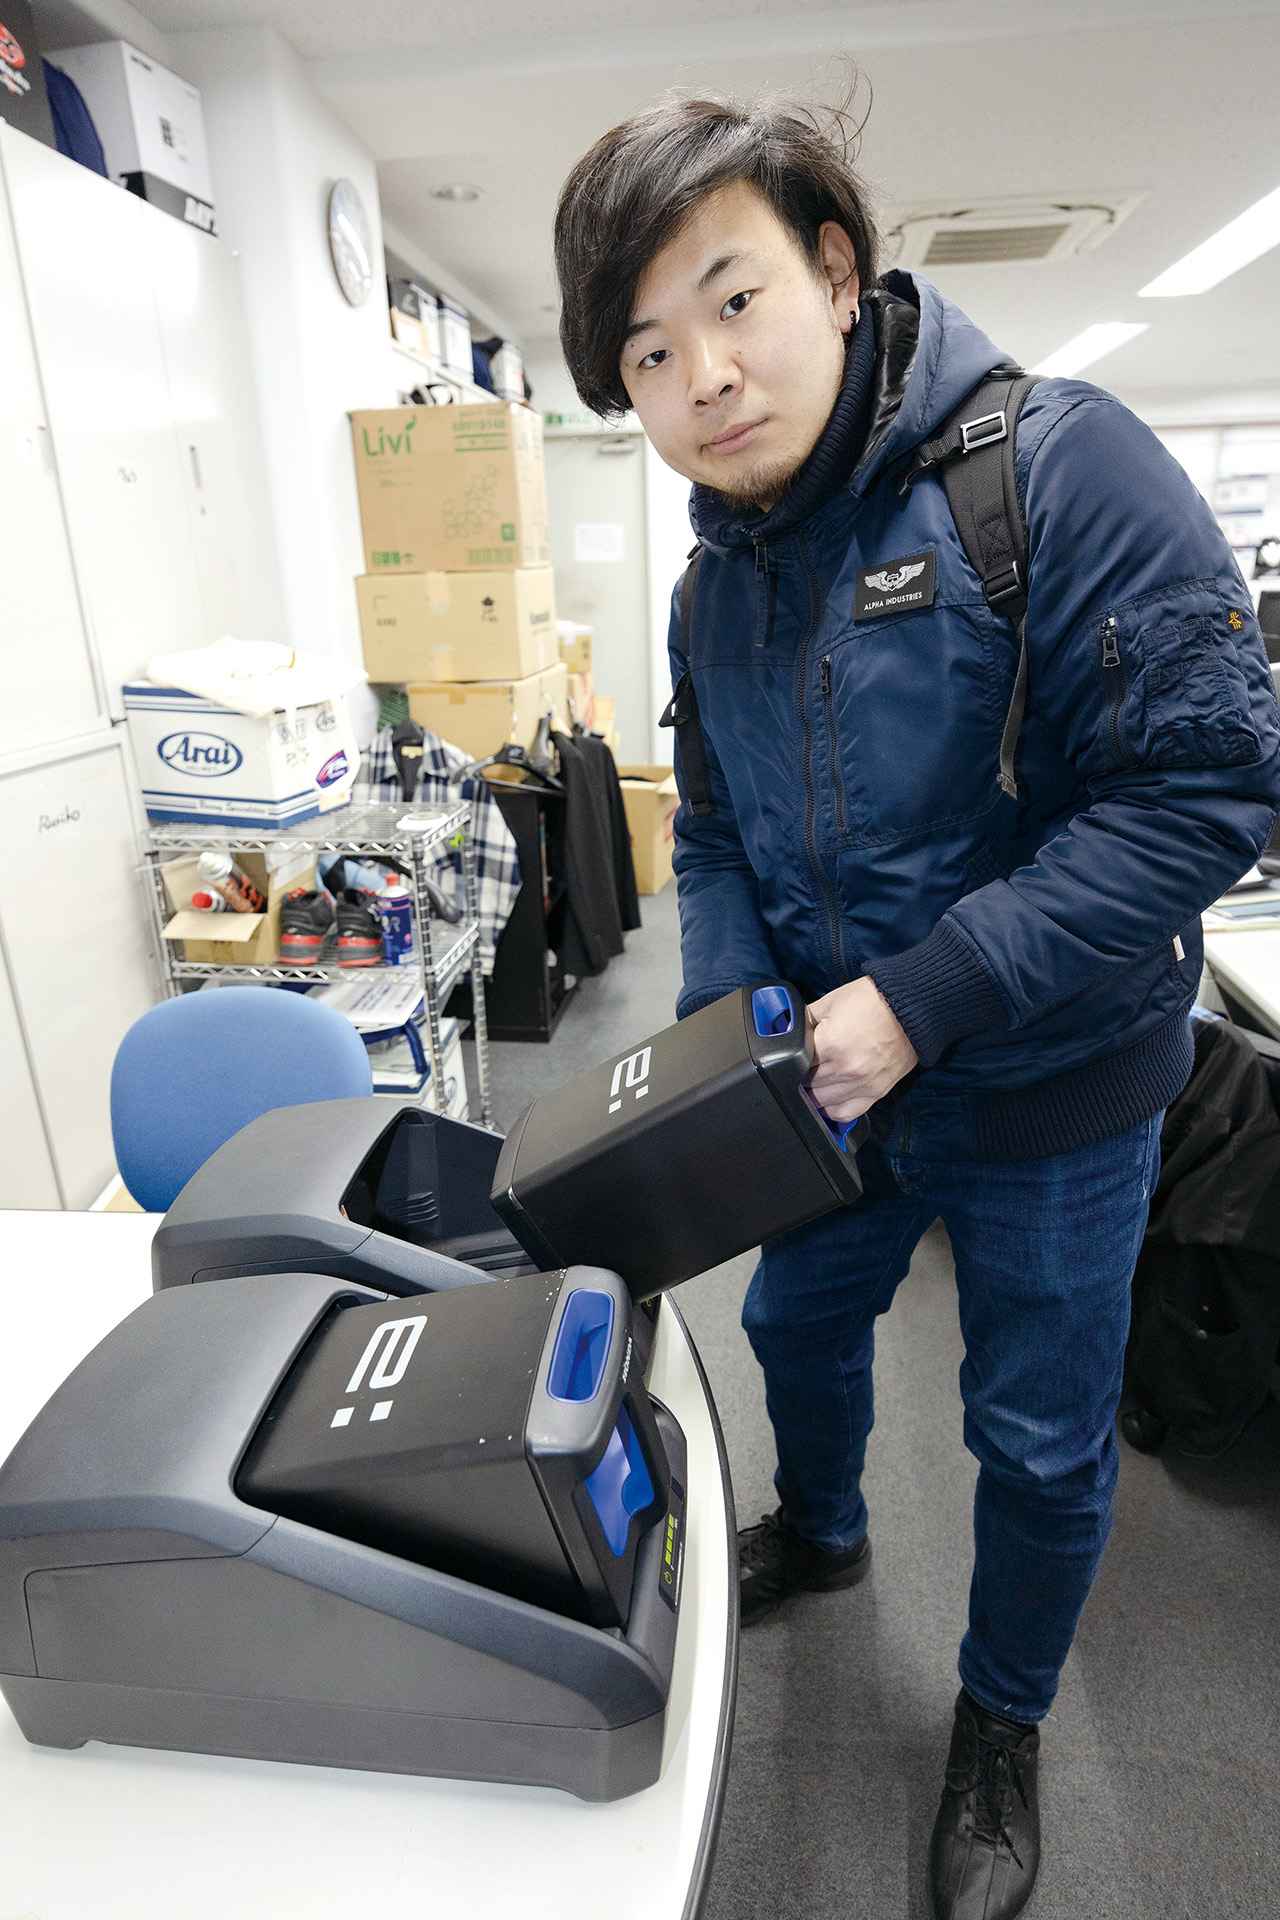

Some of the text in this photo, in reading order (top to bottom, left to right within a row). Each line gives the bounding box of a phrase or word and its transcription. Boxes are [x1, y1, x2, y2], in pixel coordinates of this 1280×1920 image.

[362, 415, 416, 457] Livi
[864, 592, 922, 611] ALPHA INDUSTRIES
[166, 736, 230, 764] Arai
